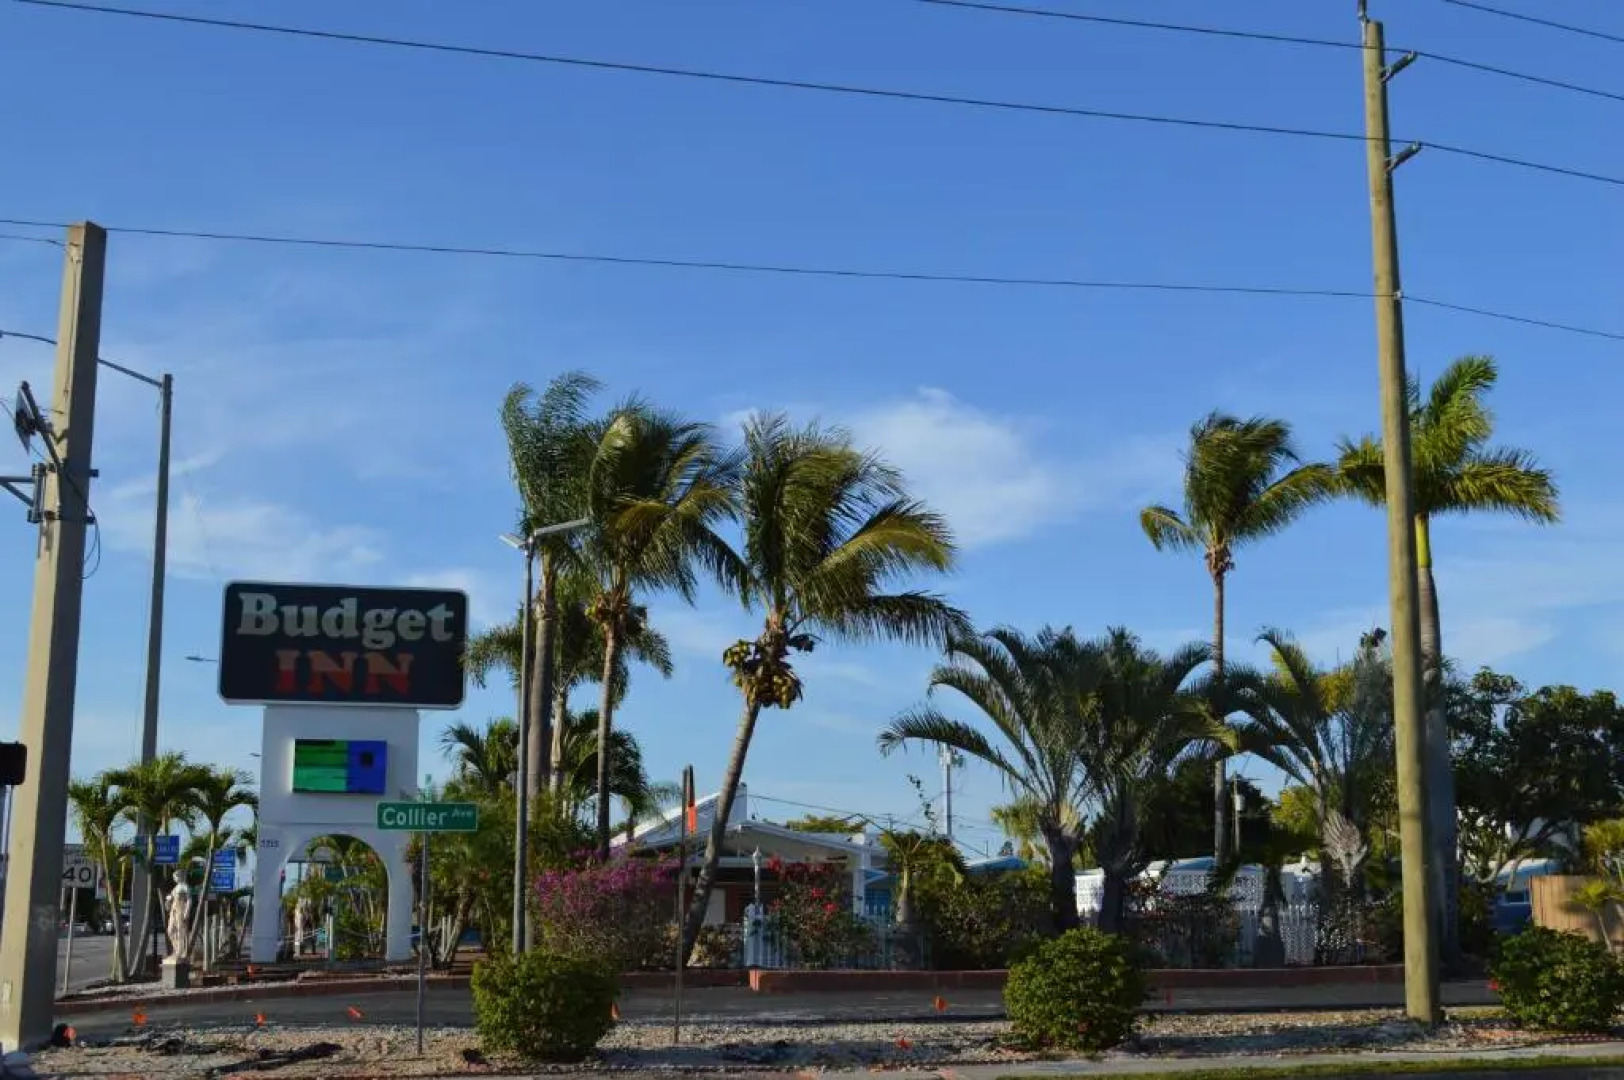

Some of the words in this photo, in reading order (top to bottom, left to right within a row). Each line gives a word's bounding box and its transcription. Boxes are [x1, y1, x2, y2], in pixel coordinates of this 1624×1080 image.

[237, 592, 455, 650] Budget
[273, 650, 414, 695] INN
[382, 806, 448, 826] Collier
[62, 866, 92, 882] 40
